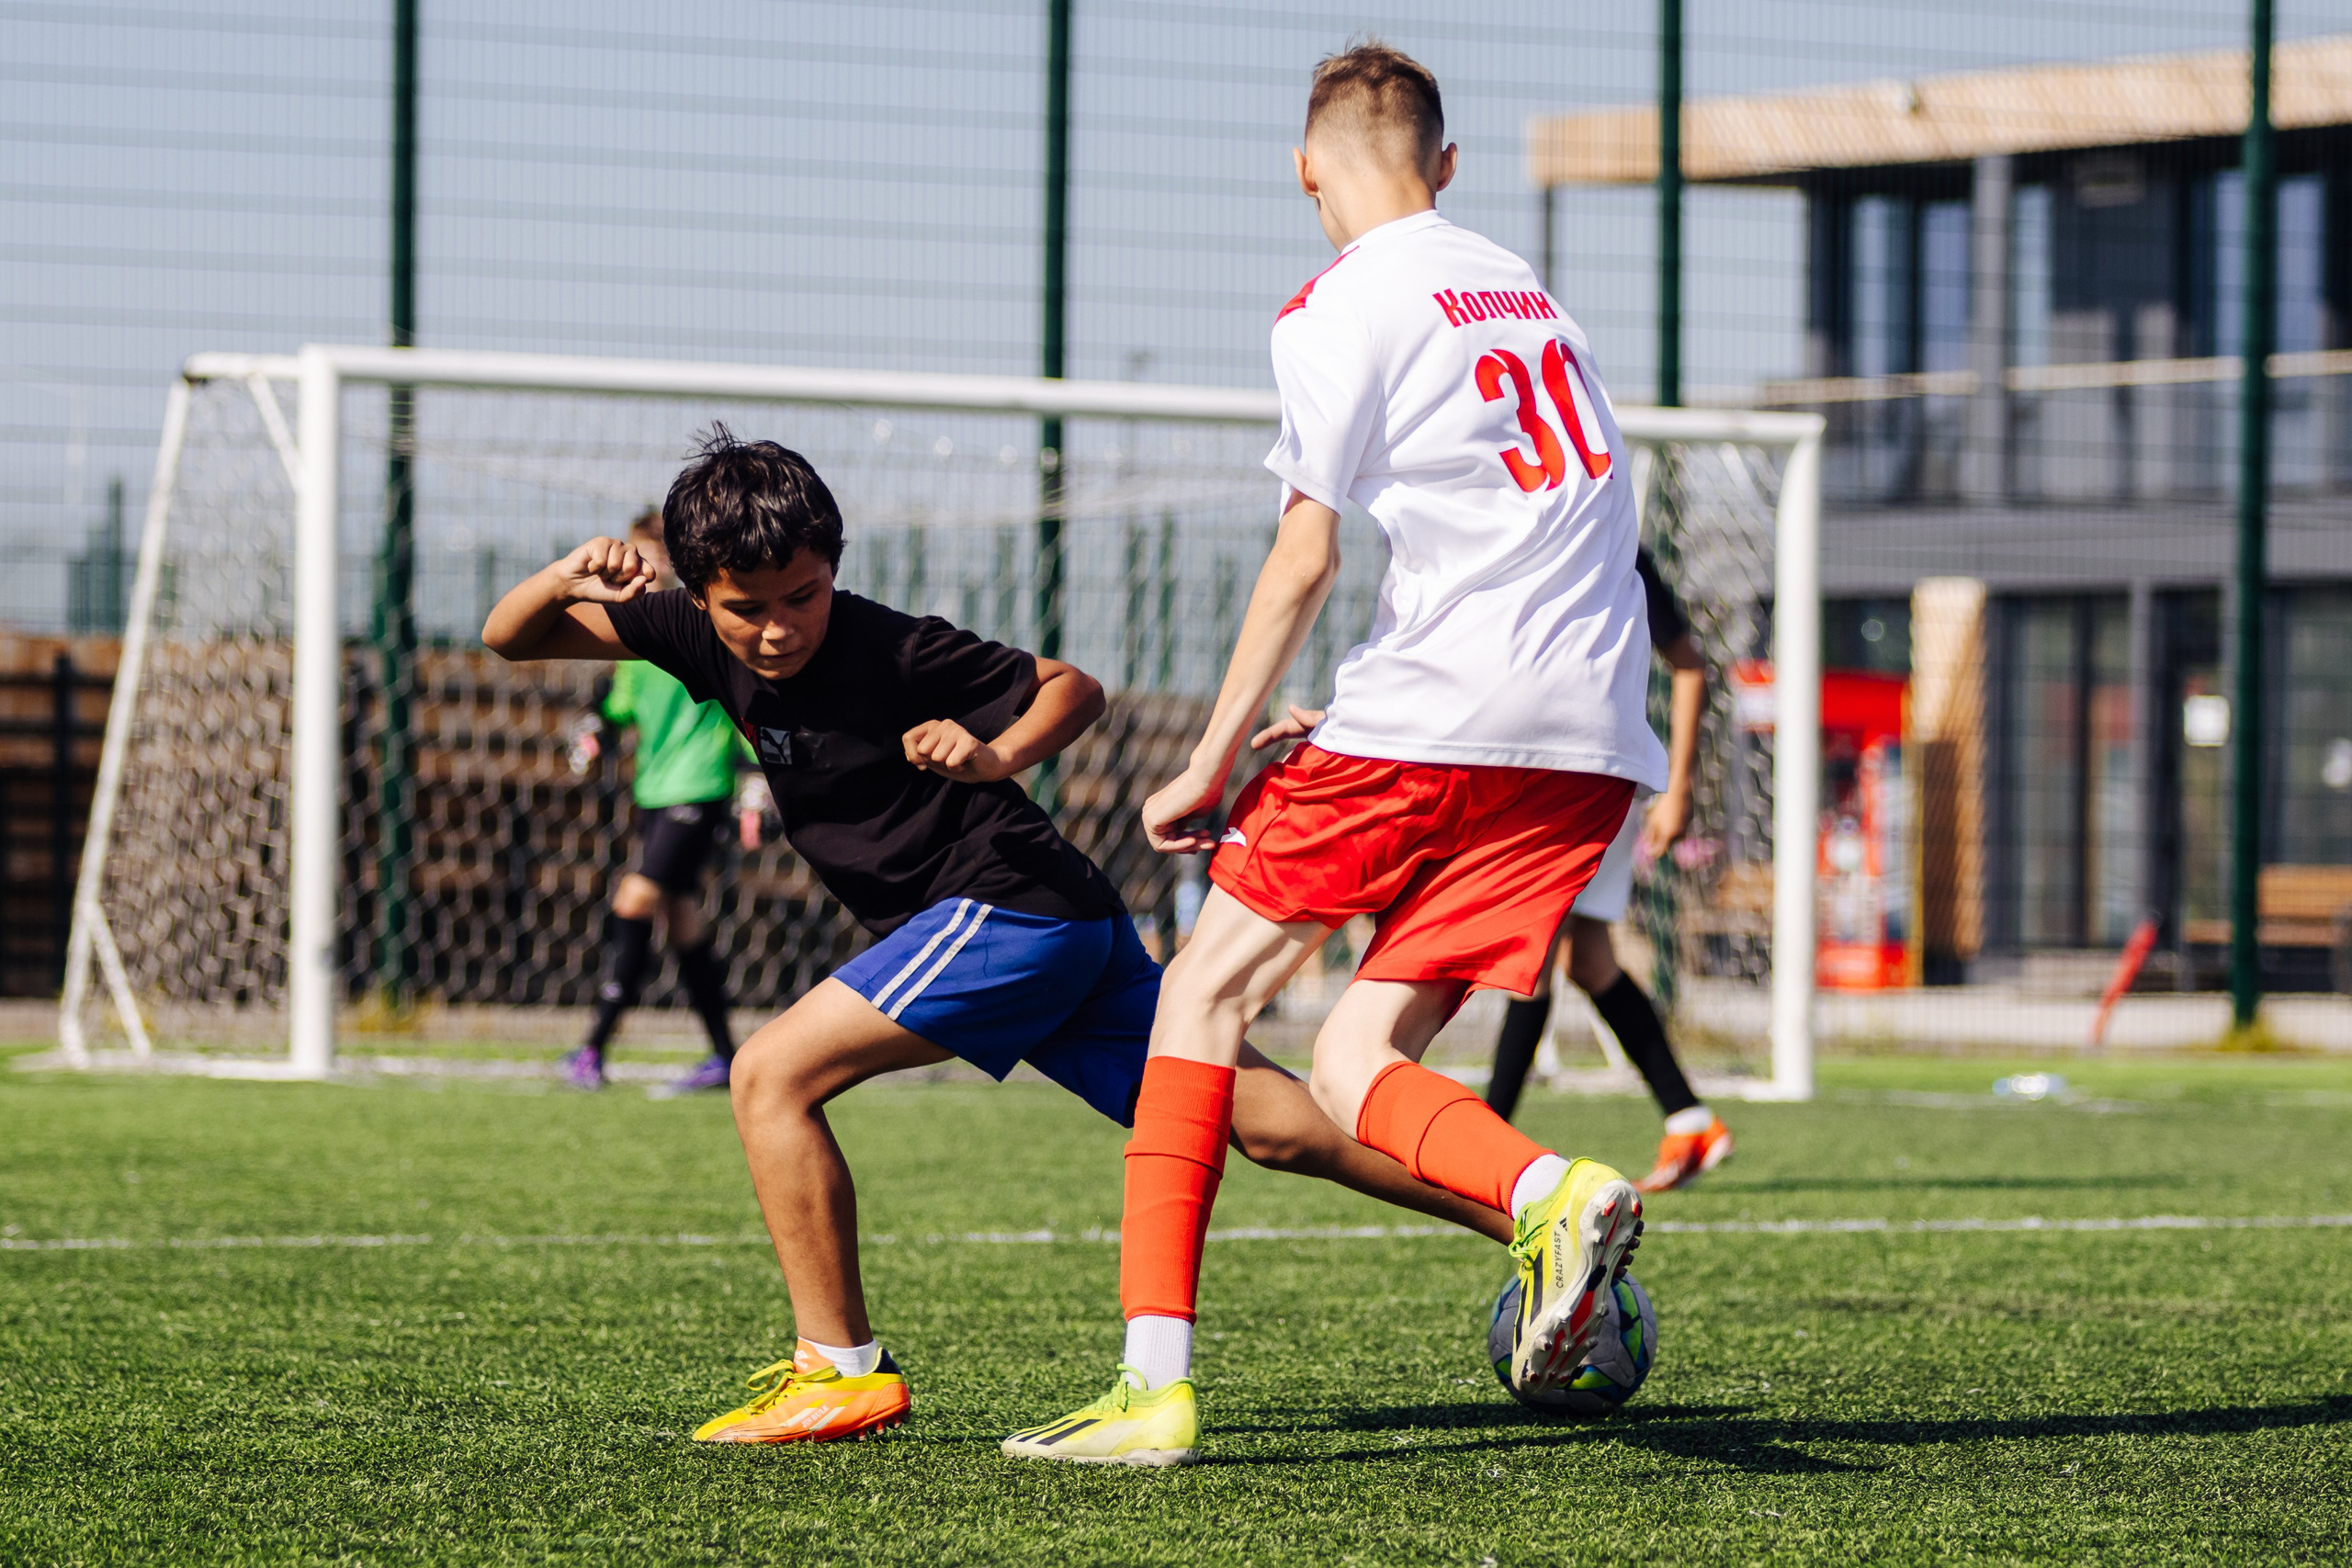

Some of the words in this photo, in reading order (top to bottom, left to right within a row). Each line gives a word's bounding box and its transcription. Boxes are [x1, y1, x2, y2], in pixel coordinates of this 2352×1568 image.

[1431, 288, 1558, 328] Колчин
[1475, 338, 1613, 493] 30
[1555, 1231, 1564, 1289] CRAZYFAST
